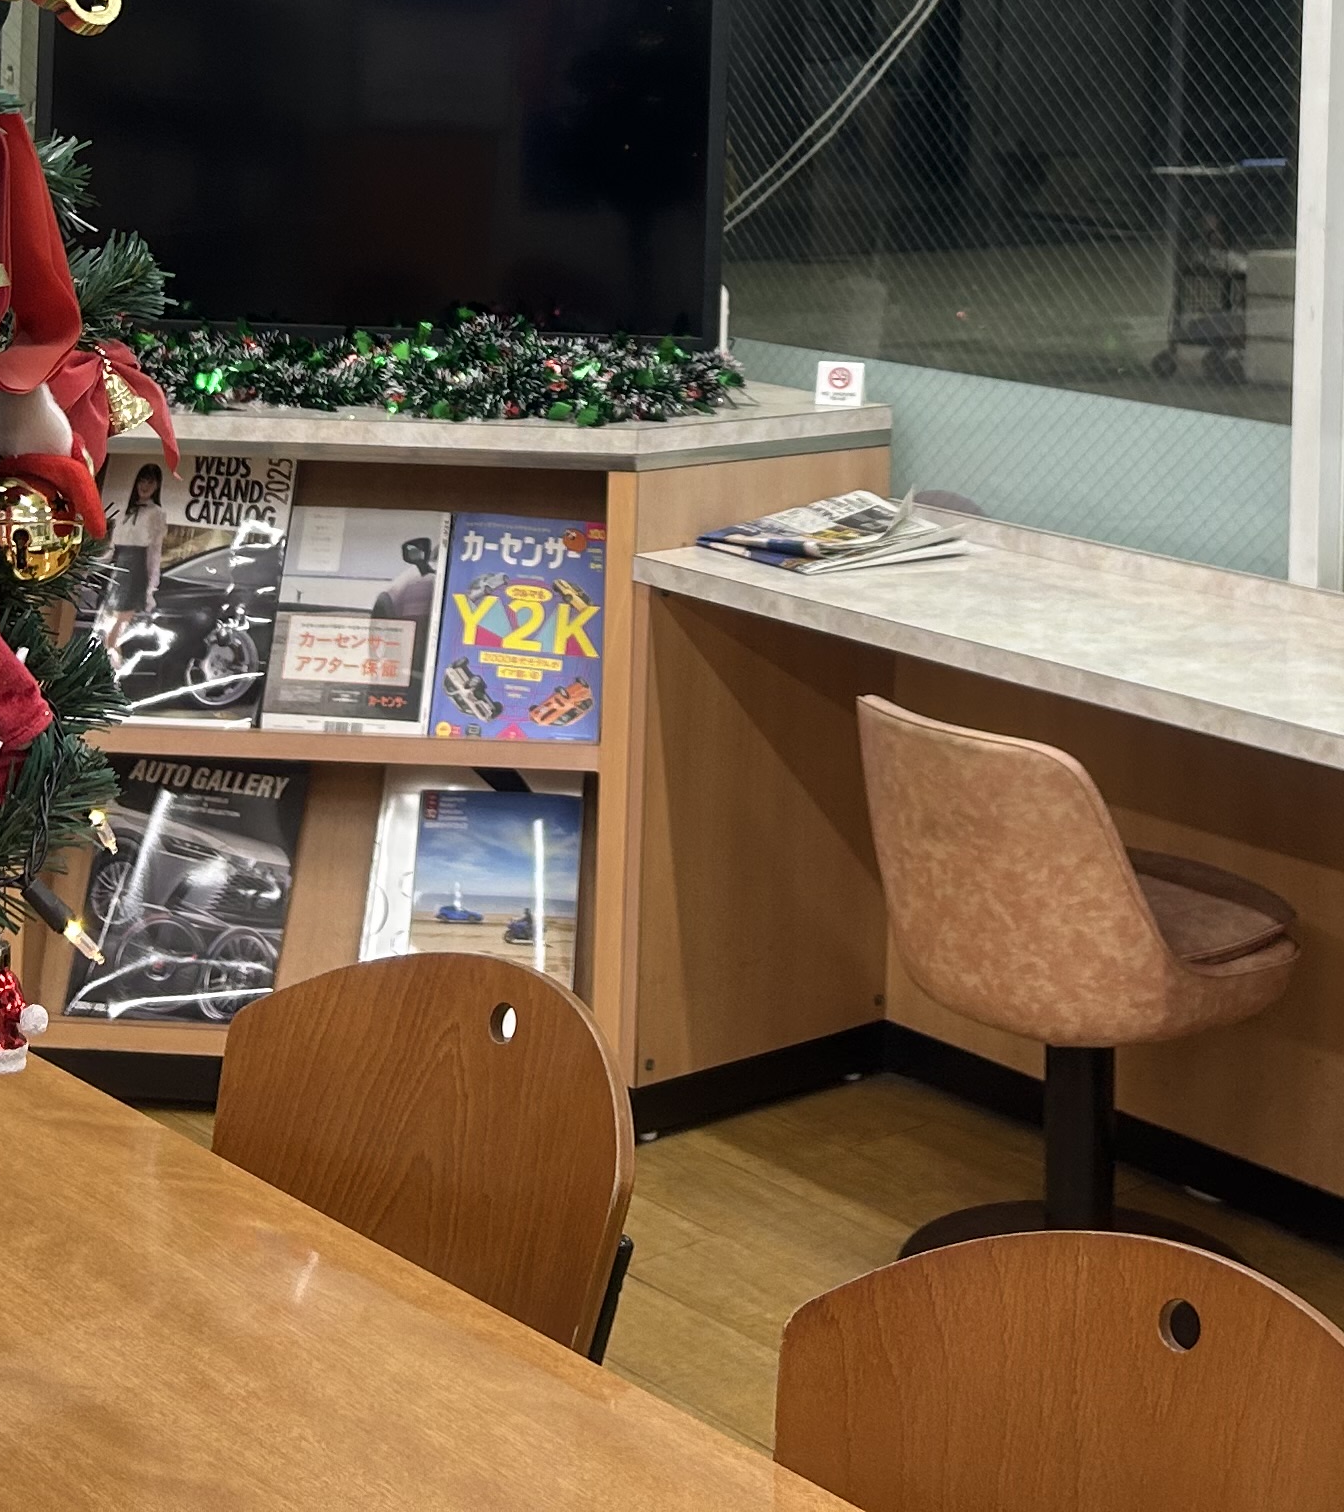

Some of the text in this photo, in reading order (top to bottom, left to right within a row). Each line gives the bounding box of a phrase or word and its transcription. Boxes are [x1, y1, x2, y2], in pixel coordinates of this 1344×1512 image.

[192, 455, 253, 478] WEDS
[188, 474, 265, 504] GRAND
[263, 457, 294, 507] 2025
[184, 498, 277, 528] CATALOG
[459, 530, 582, 569] カーセンサー
[297, 630, 401, 652] カーセンサー
[452, 593, 601, 659] Y2K
[293, 655, 401, 679] アフター保証
[128, 758, 290, 800] AUTO GALLERY
